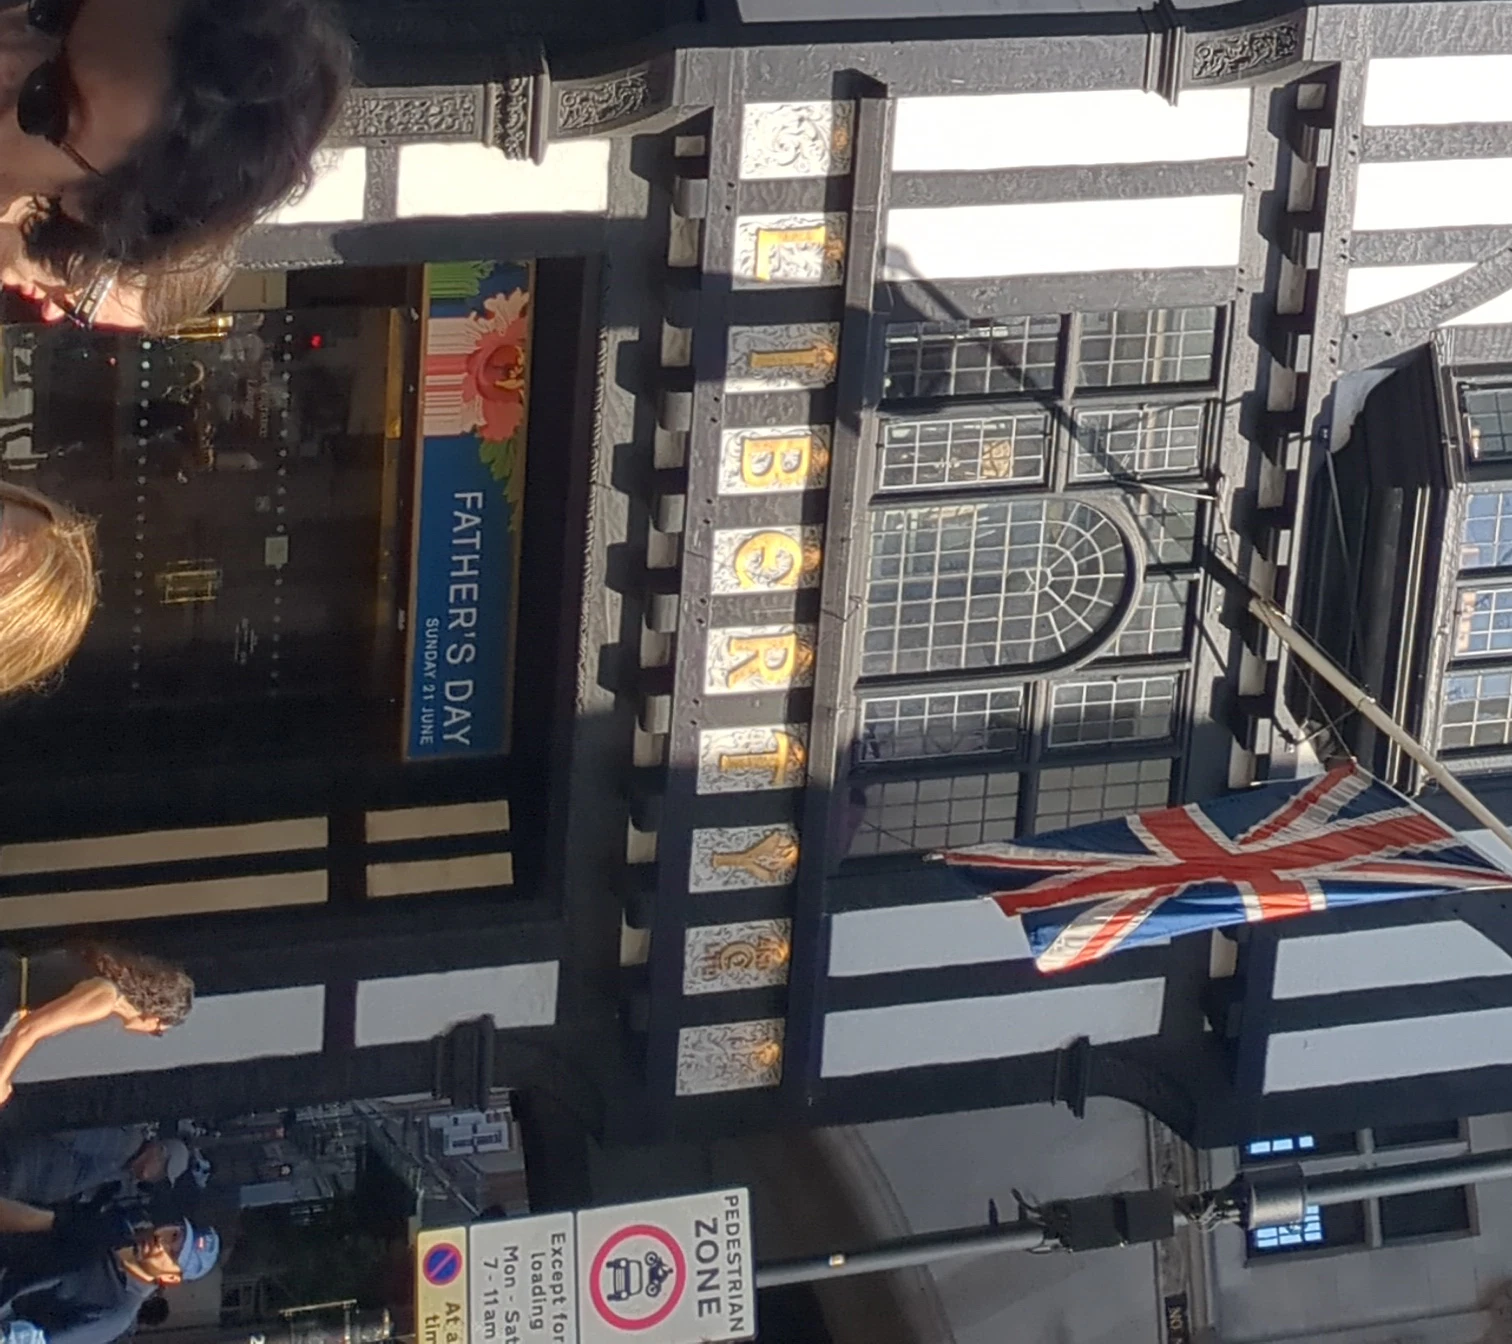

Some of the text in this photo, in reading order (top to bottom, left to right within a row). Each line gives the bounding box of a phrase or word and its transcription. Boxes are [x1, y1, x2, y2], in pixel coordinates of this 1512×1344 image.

[711, 226, 827, 883] LIBERTY
[442, 491, 484, 746] FATHER'S DAY
[420, 617, 440, 746] SUNDAY 21 JUNE
[445, 1302, 461, 1325] At
[484, 1257, 499, 1269] 7
[504, 1245, 519, 1288] Mon
[529, 1252, 547, 1330] loading
[549, 1232, 568, 1343] Except for
[695, 1217, 721, 1318] ZONE
[725, 1195, 745, 1332] PEDESTRIAN
[505, 1310, 521, 1344] Sat
